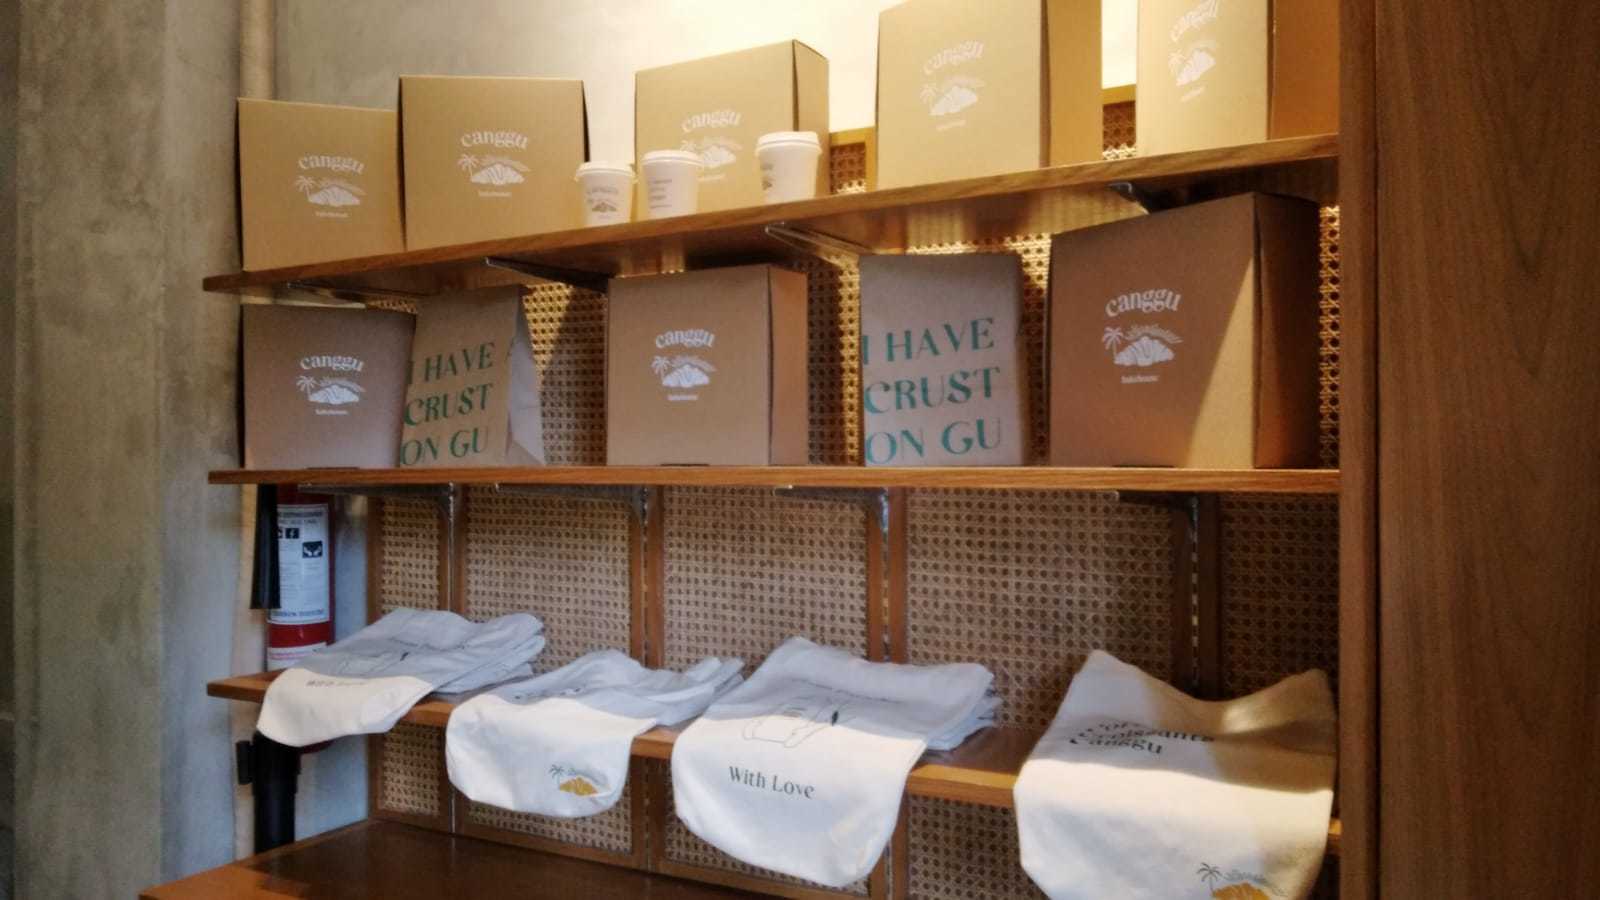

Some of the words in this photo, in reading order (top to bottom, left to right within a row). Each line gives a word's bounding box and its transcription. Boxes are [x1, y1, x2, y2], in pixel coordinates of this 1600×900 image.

[460, 130, 529, 149] canggu
[298, 154, 365, 174] canggu
[1105, 288, 1181, 317] canggu
[655, 328, 715, 348] canggu
[862, 335, 869, 365] I
[886, 317, 995, 362] HAVE
[300, 354, 364, 371] canggu
[424, 342, 495, 382] HAVE
[403, 383, 493, 426] CRUST
[864, 366, 1001, 414] CRUST
[400, 434, 440, 466] ON
[450, 427, 488, 458] GU
[866, 428, 924, 465] ON
[941, 417, 1002, 455] GU
[729, 766, 766, 789] With
[772, 775, 815, 799] Love
